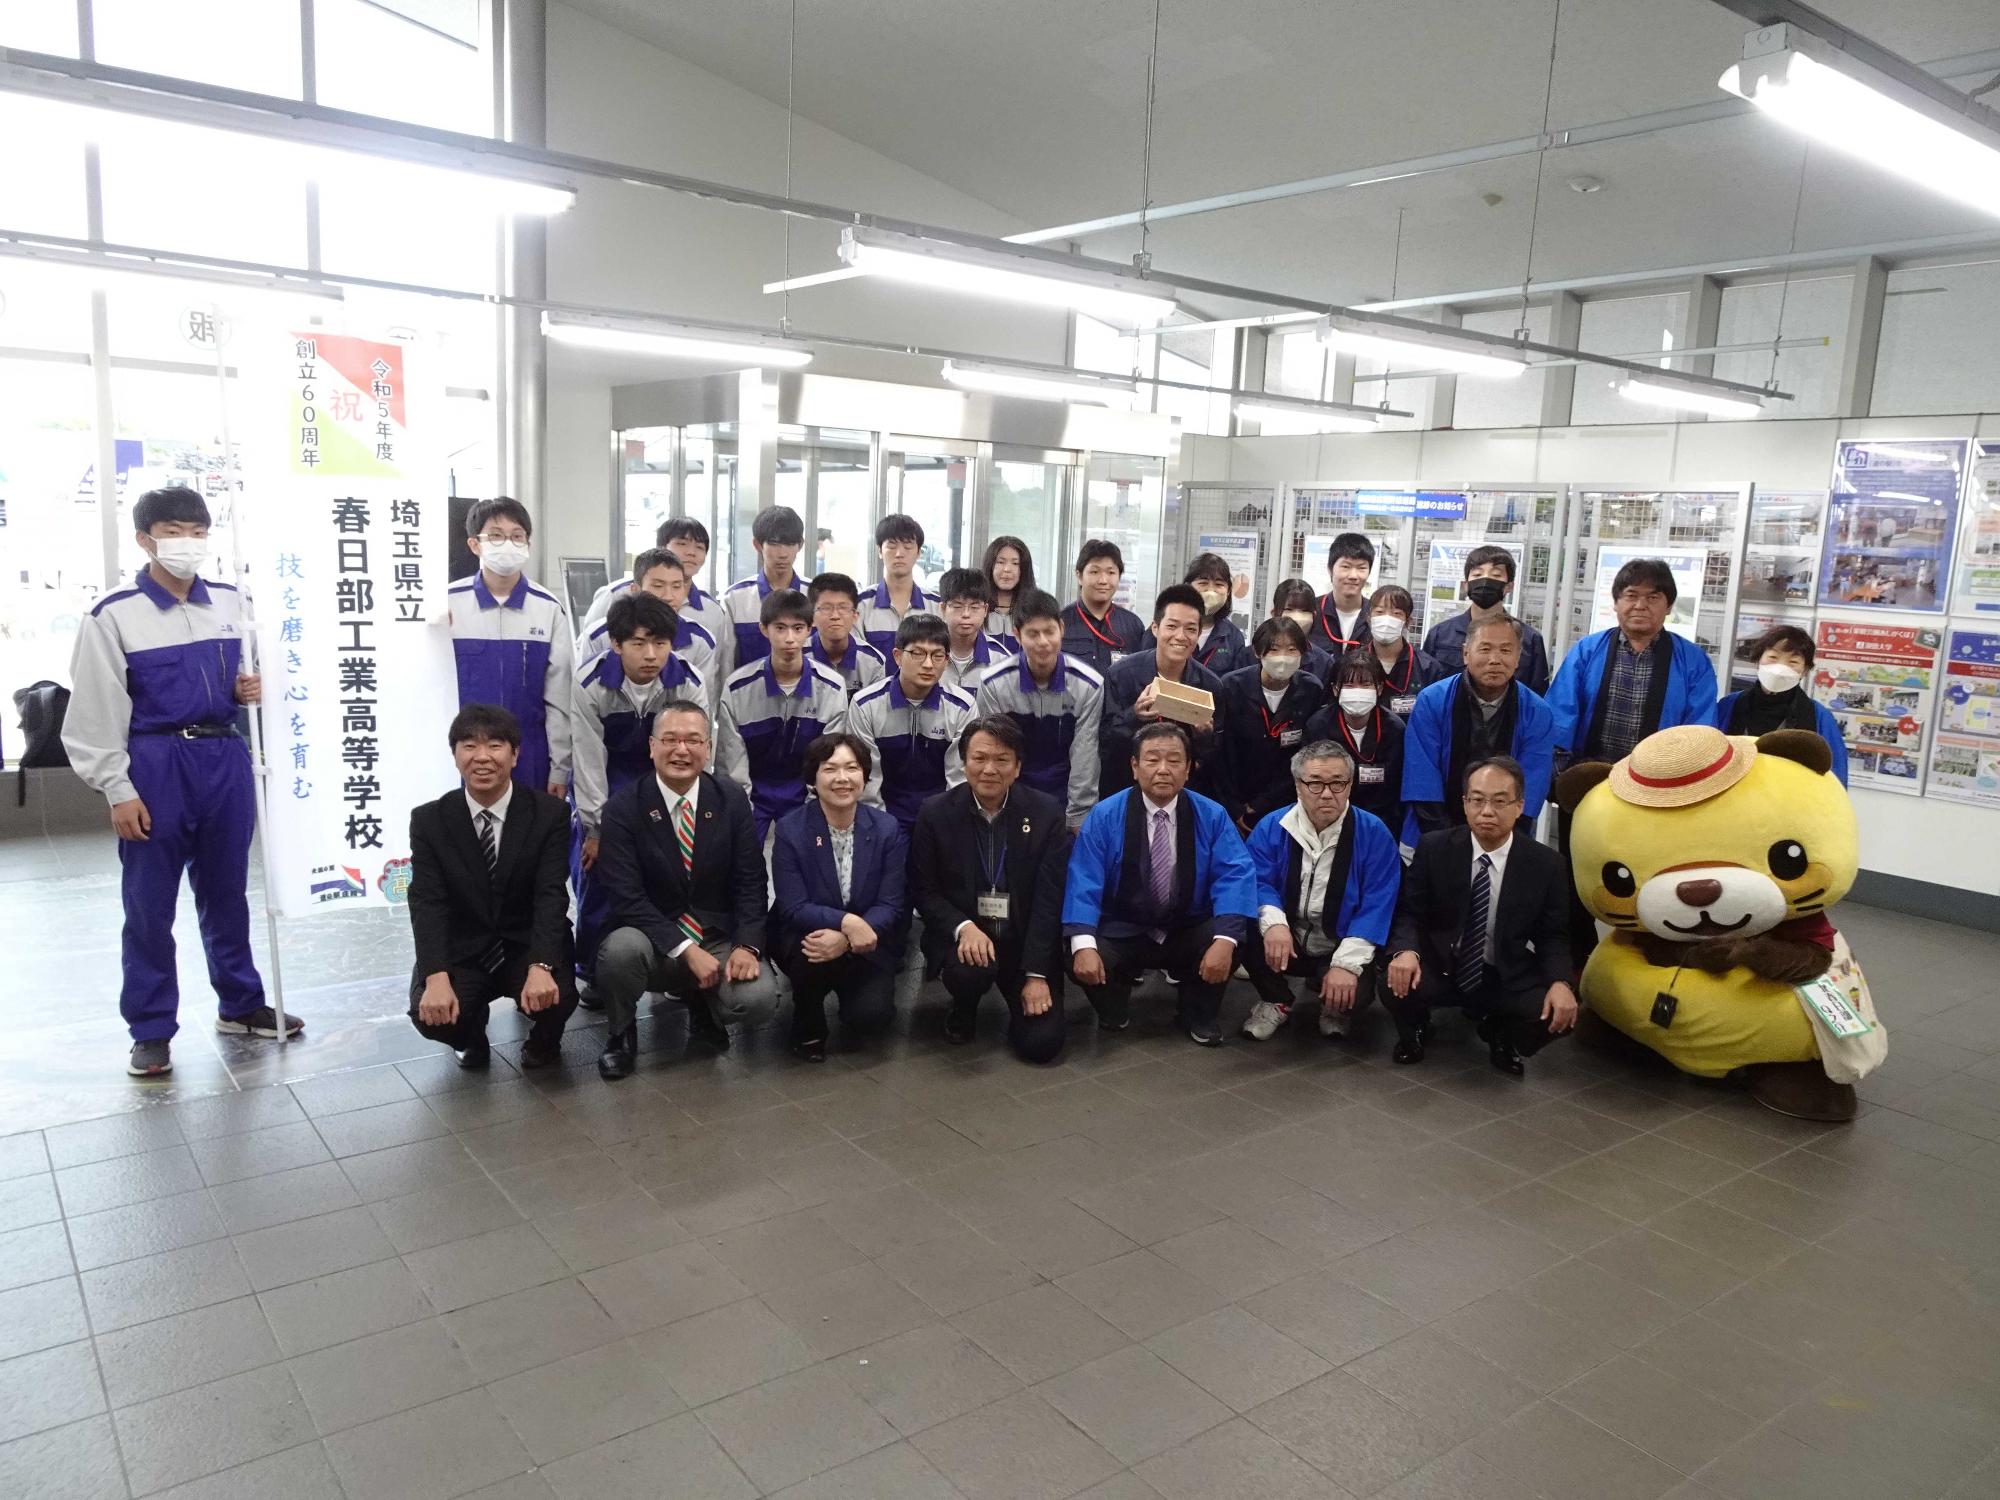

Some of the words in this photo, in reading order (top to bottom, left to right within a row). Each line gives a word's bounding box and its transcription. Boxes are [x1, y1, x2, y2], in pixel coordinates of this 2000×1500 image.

[295, 339, 321, 468] 創立60周年
[329, 389, 364, 423] 祝
[371, 359, 394, 462] 令和5年度
[390, 498, 426, 622] 埼玉県立
[275, 552, 313, 800] 技を磨き心を育む
[331, 496, 384, 850] 春日部工業高等学校
